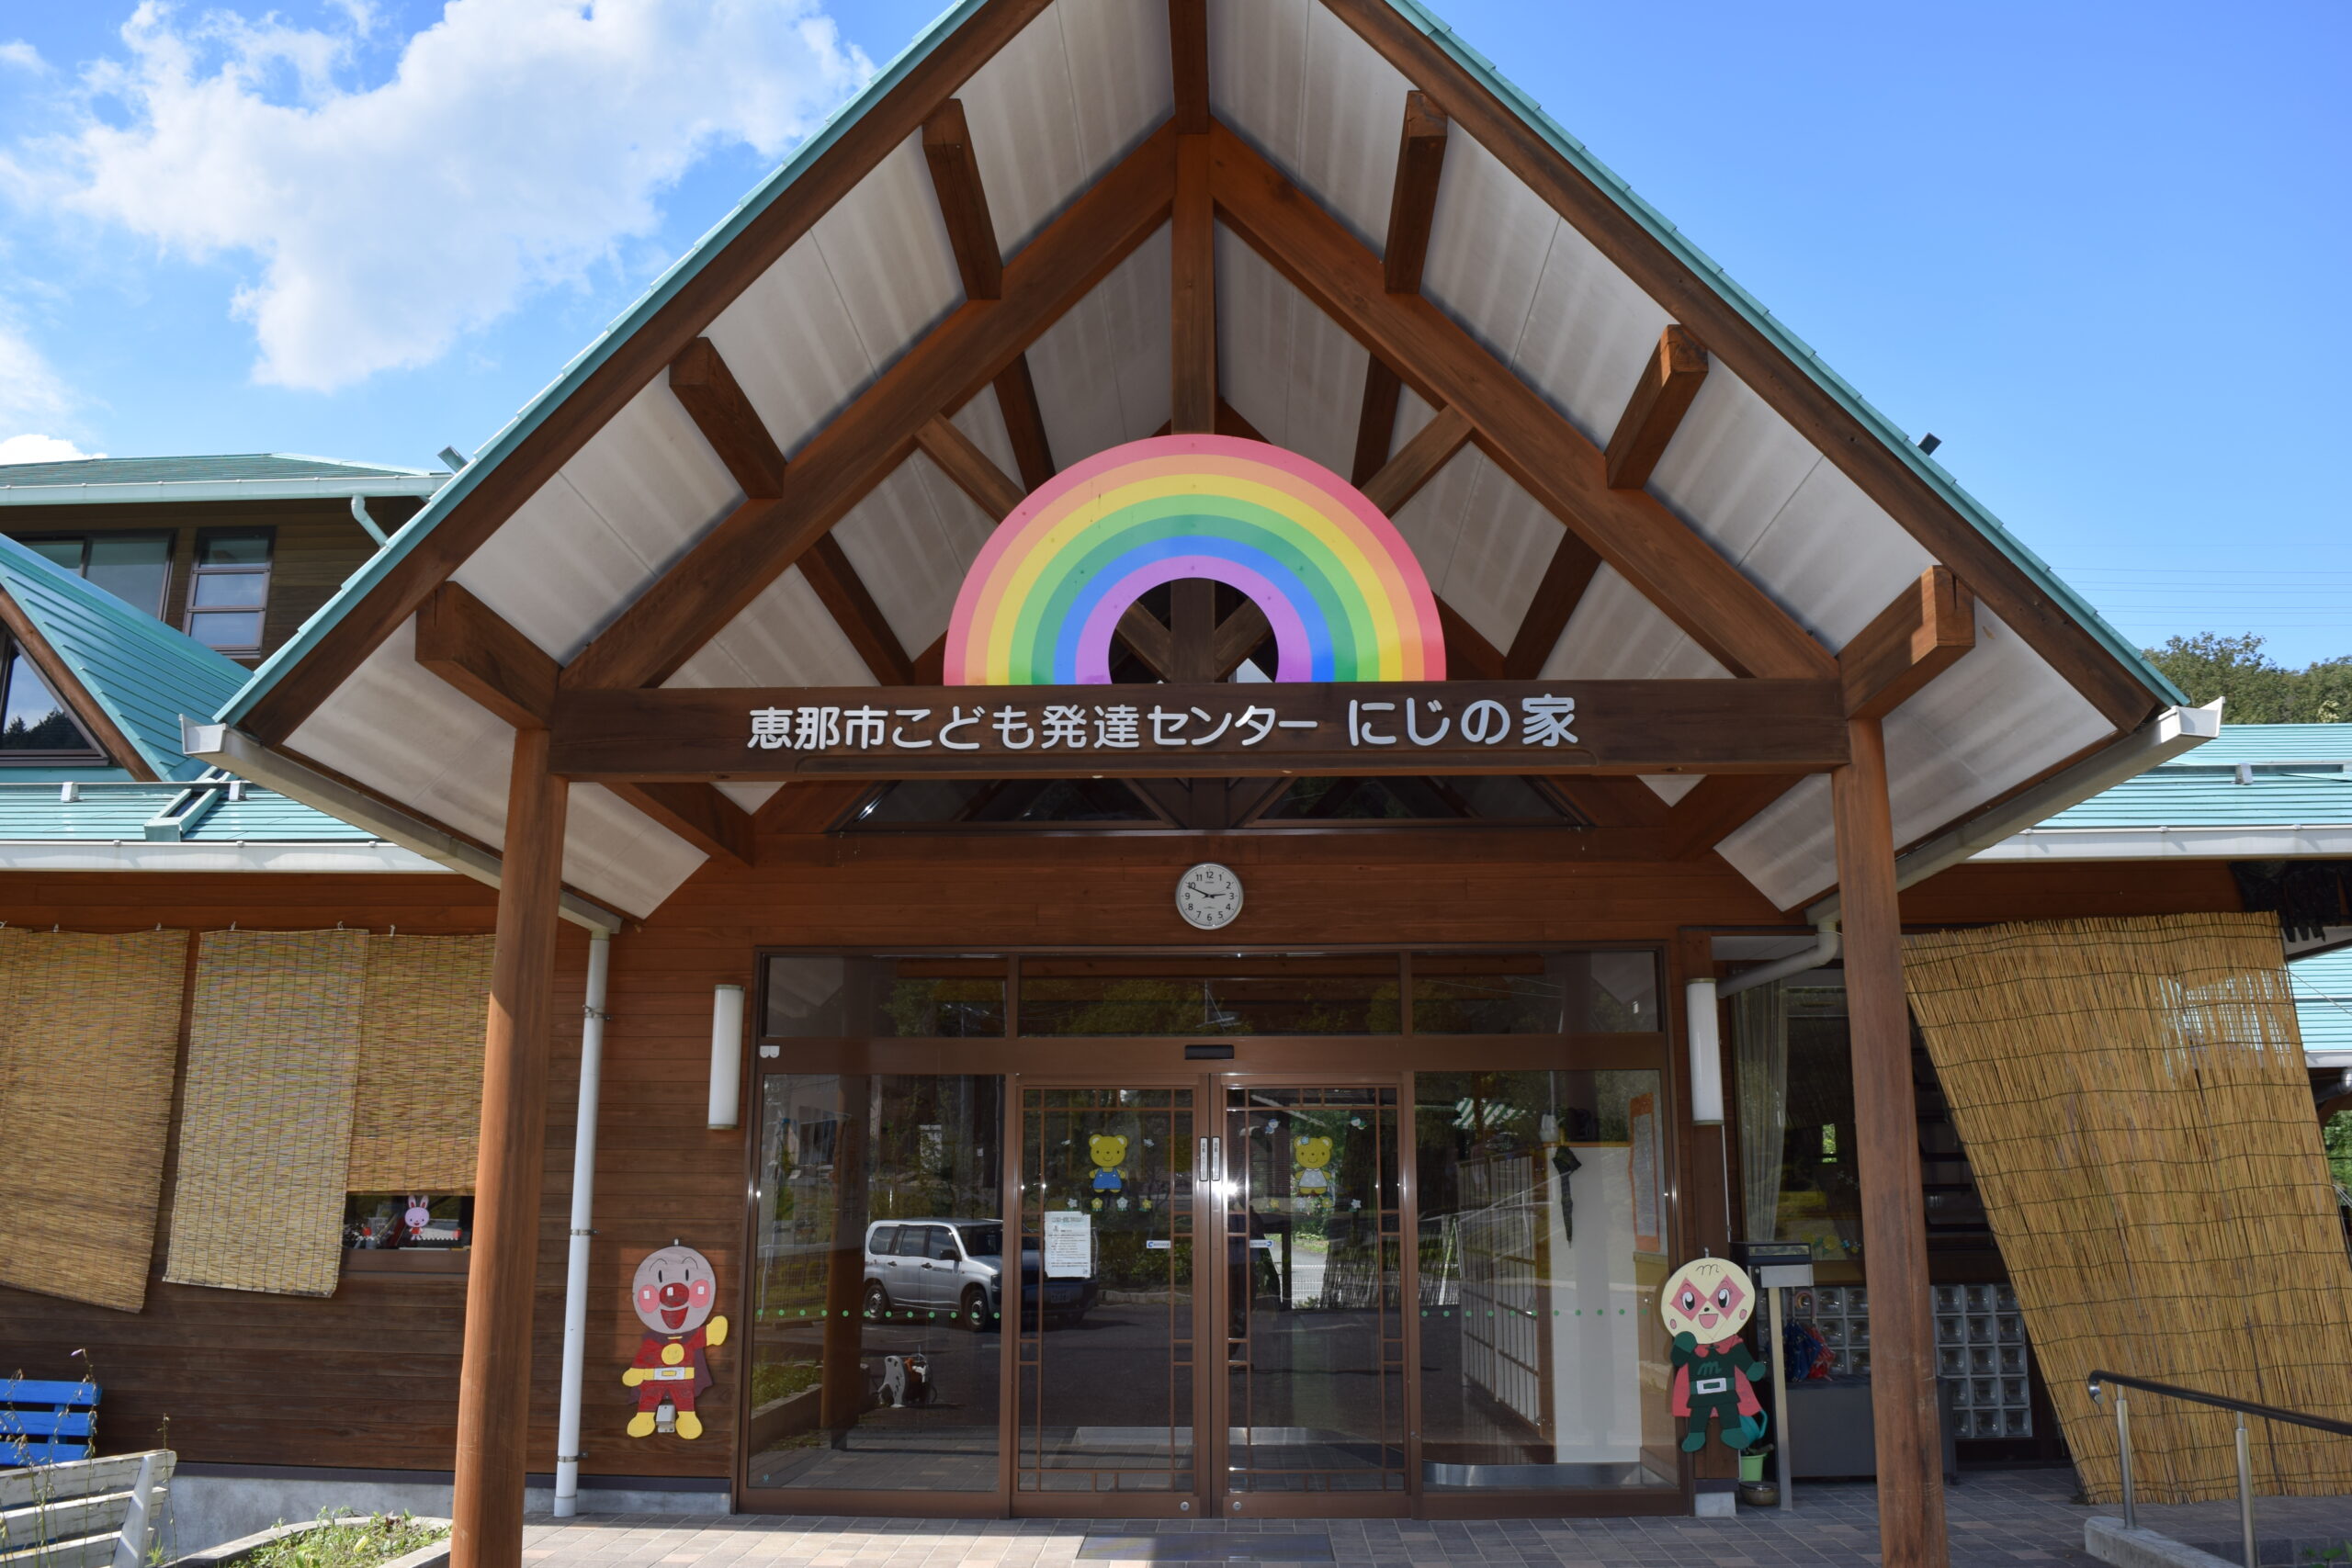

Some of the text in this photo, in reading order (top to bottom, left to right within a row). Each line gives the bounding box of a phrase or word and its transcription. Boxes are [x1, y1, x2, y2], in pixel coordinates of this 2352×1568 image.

[747, 694, 1578, 750] 恵那市こども発達センター にじの家
